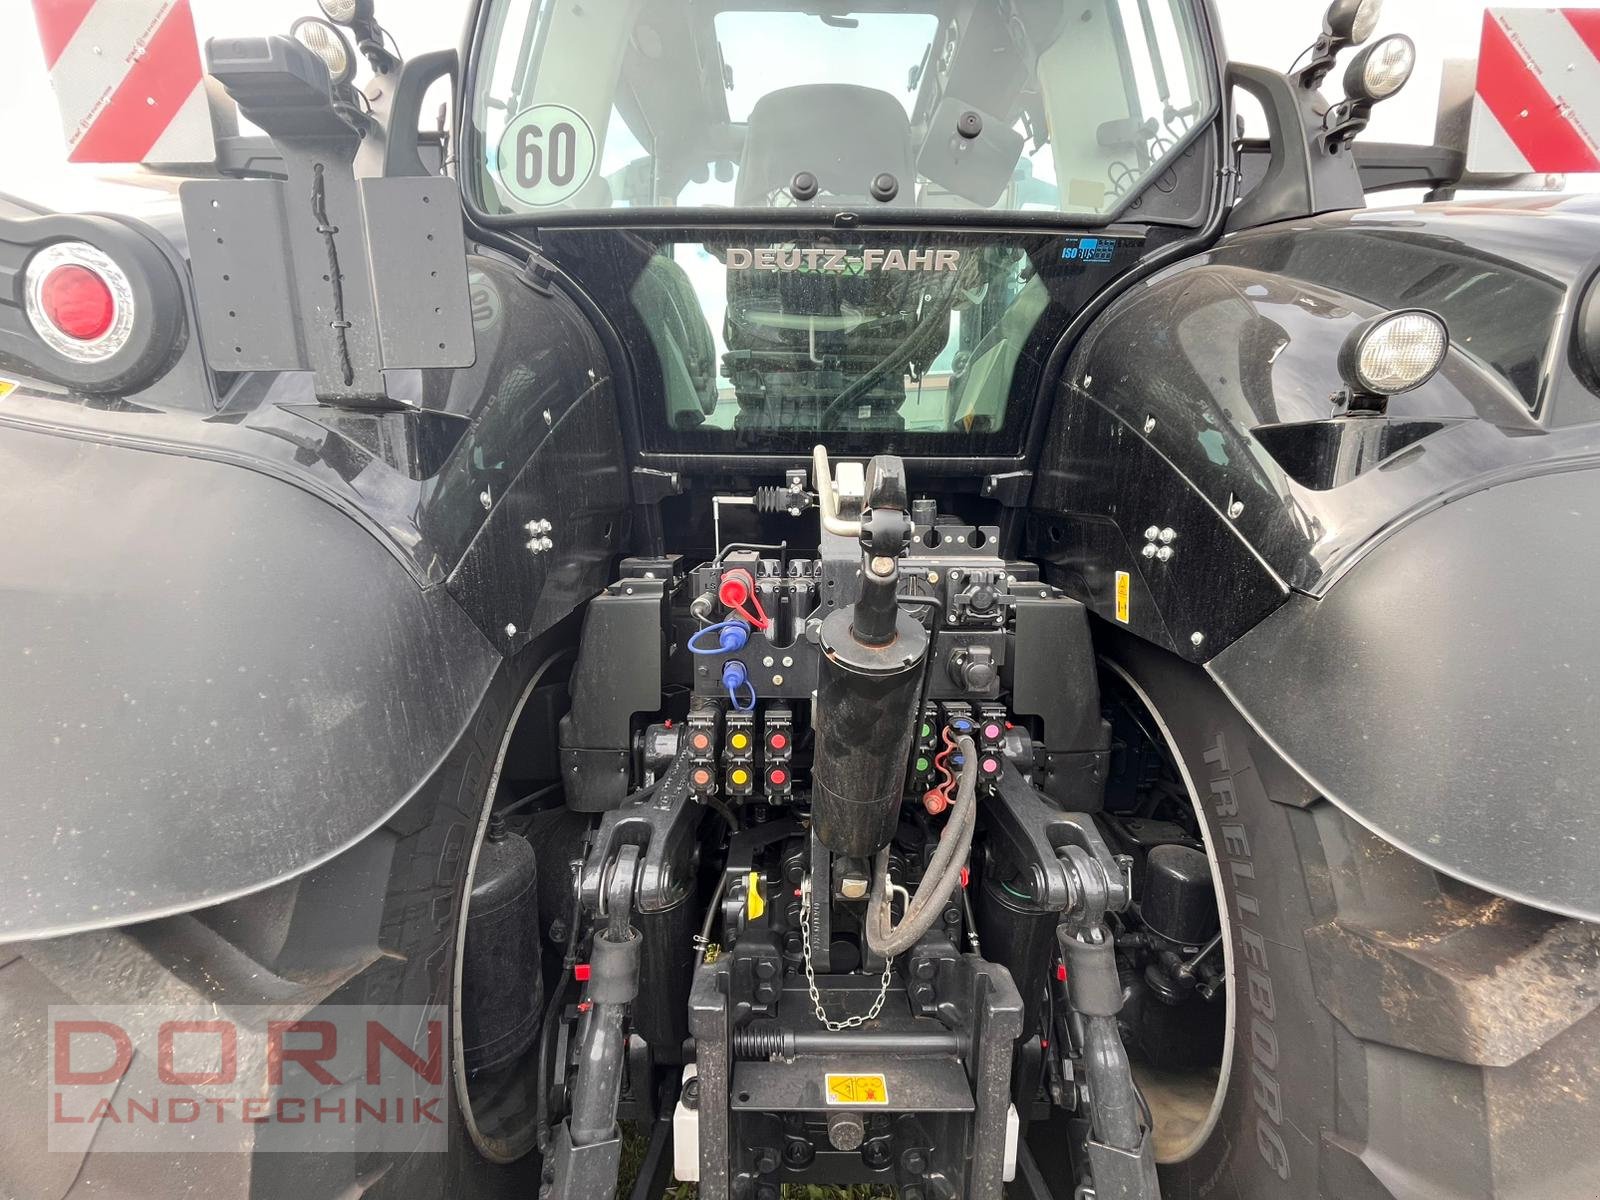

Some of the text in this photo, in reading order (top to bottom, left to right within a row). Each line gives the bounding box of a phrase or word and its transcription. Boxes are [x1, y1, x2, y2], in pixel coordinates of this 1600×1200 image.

[516, 123, 576, 189] 60
[726, 248, 961, 271] DEUTZ-FAHR
[1061, 247, 1096, 259] ISOBUS
[1202, 731, 1291, 1181] TRELLEBORG
